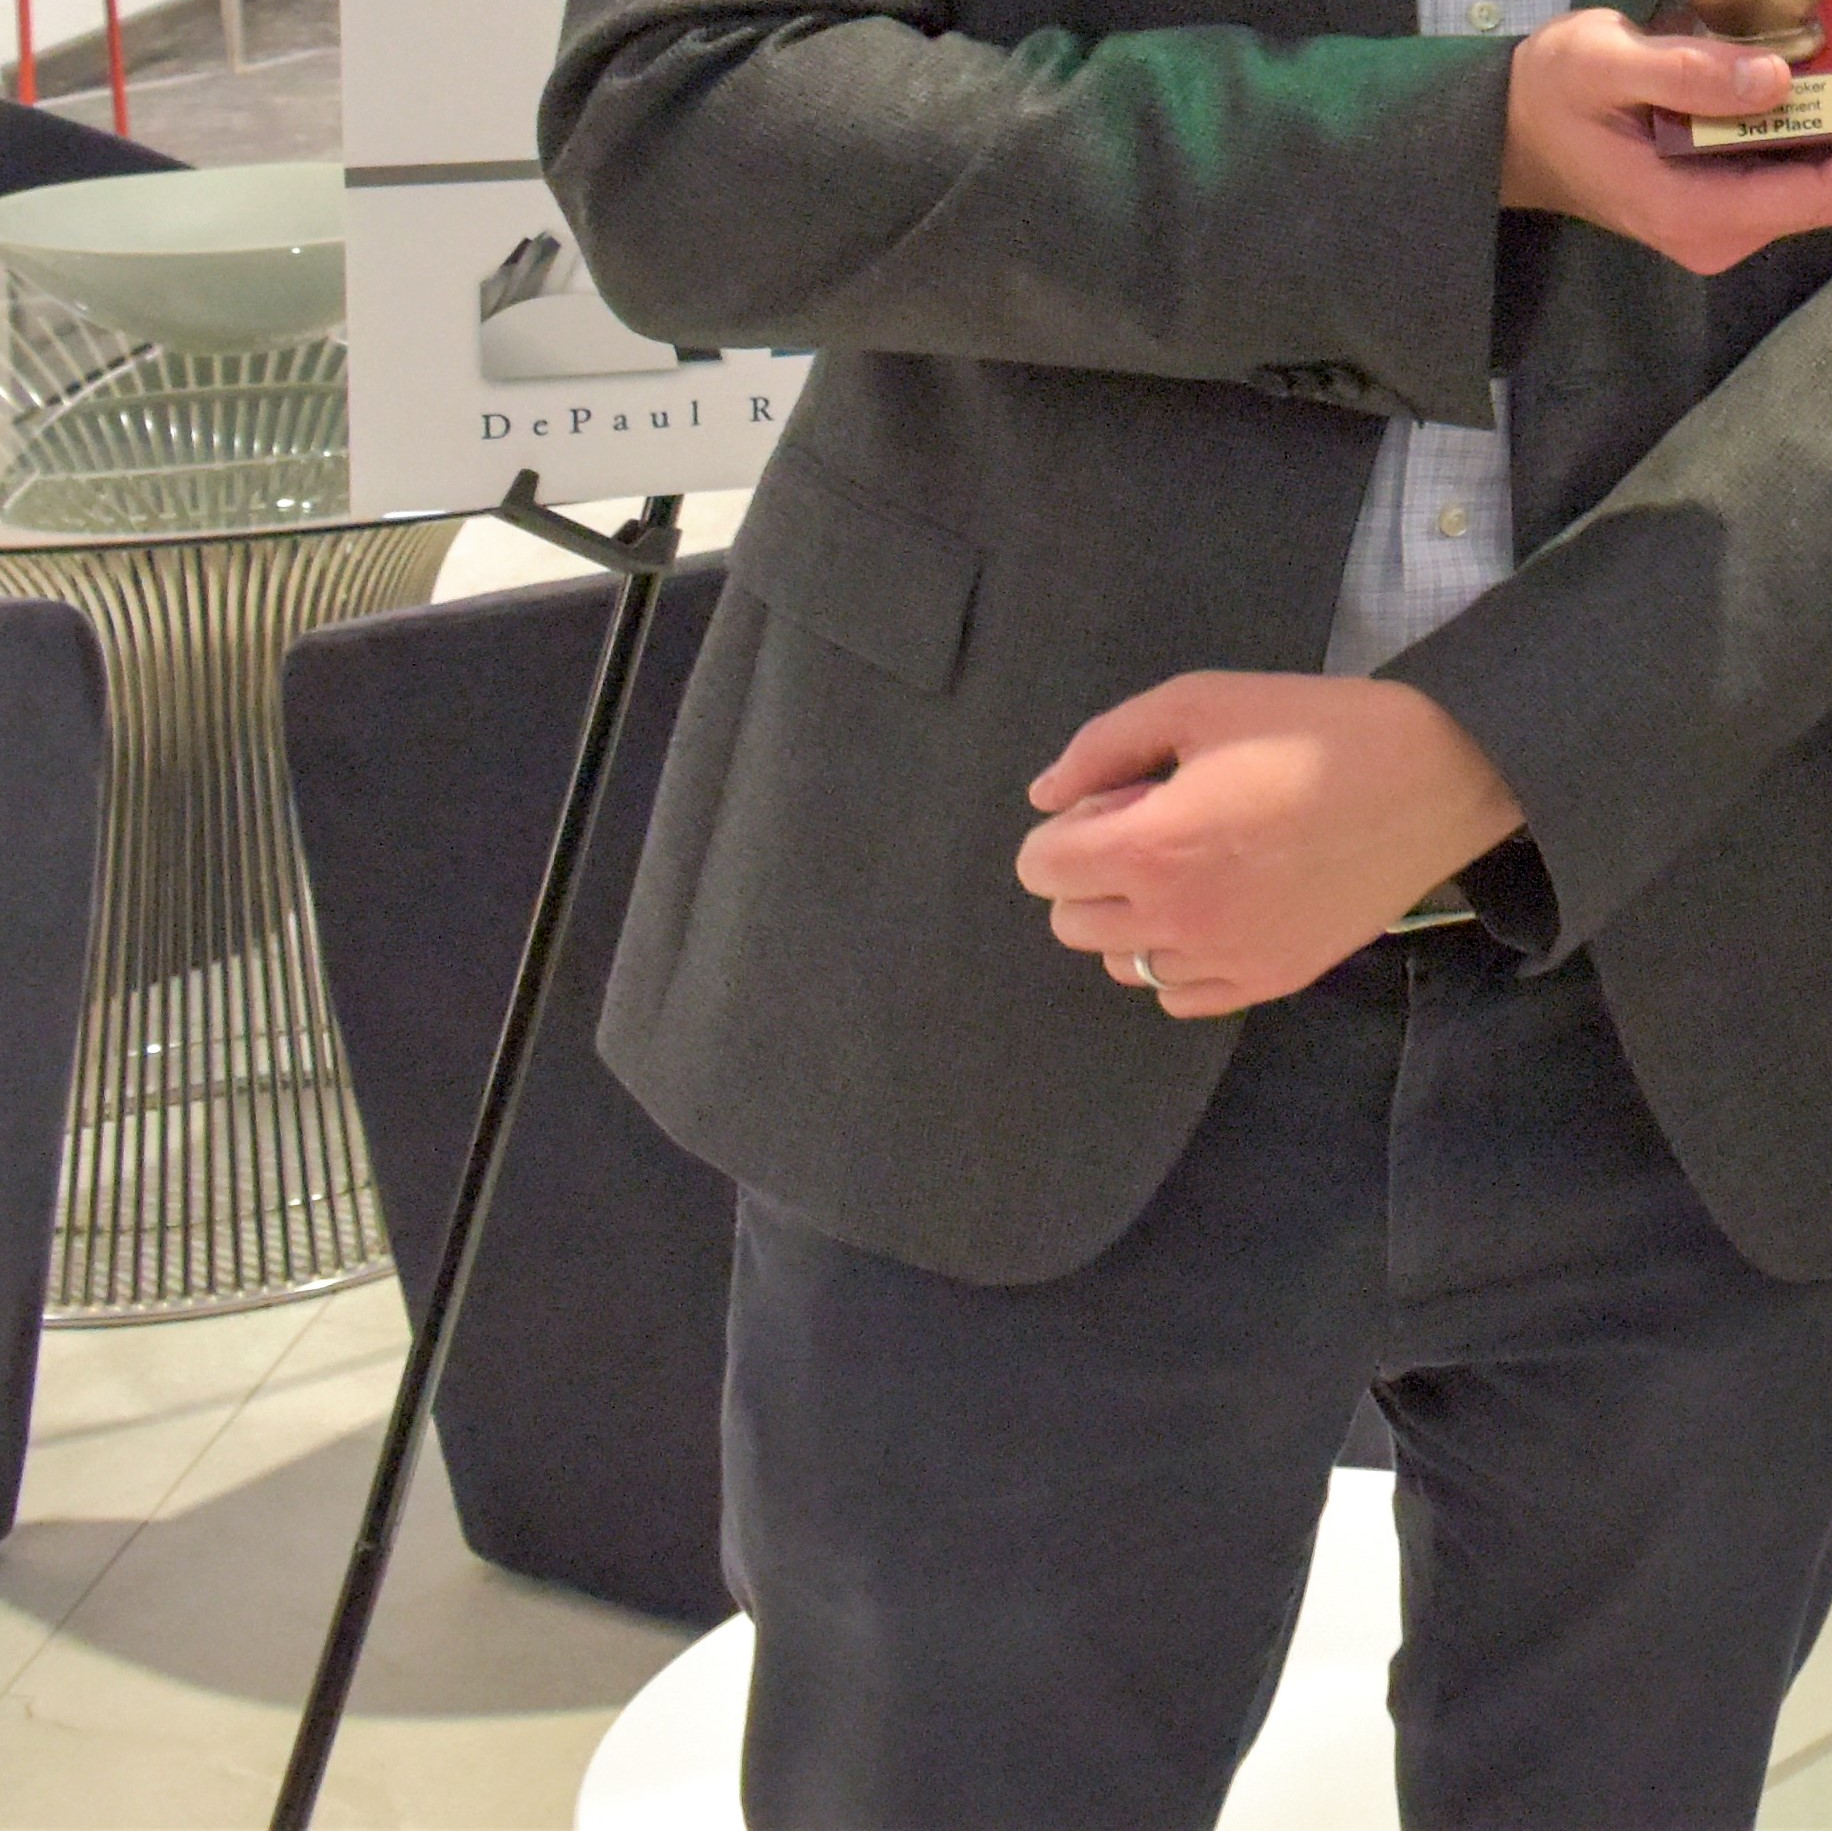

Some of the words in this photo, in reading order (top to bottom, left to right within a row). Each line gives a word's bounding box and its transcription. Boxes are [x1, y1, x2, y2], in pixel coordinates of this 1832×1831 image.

[1737, 119, 1767, 137] 3rd
[1774, 118, 1823, 134] Place
[481, 400, 701, 440] DePaul
